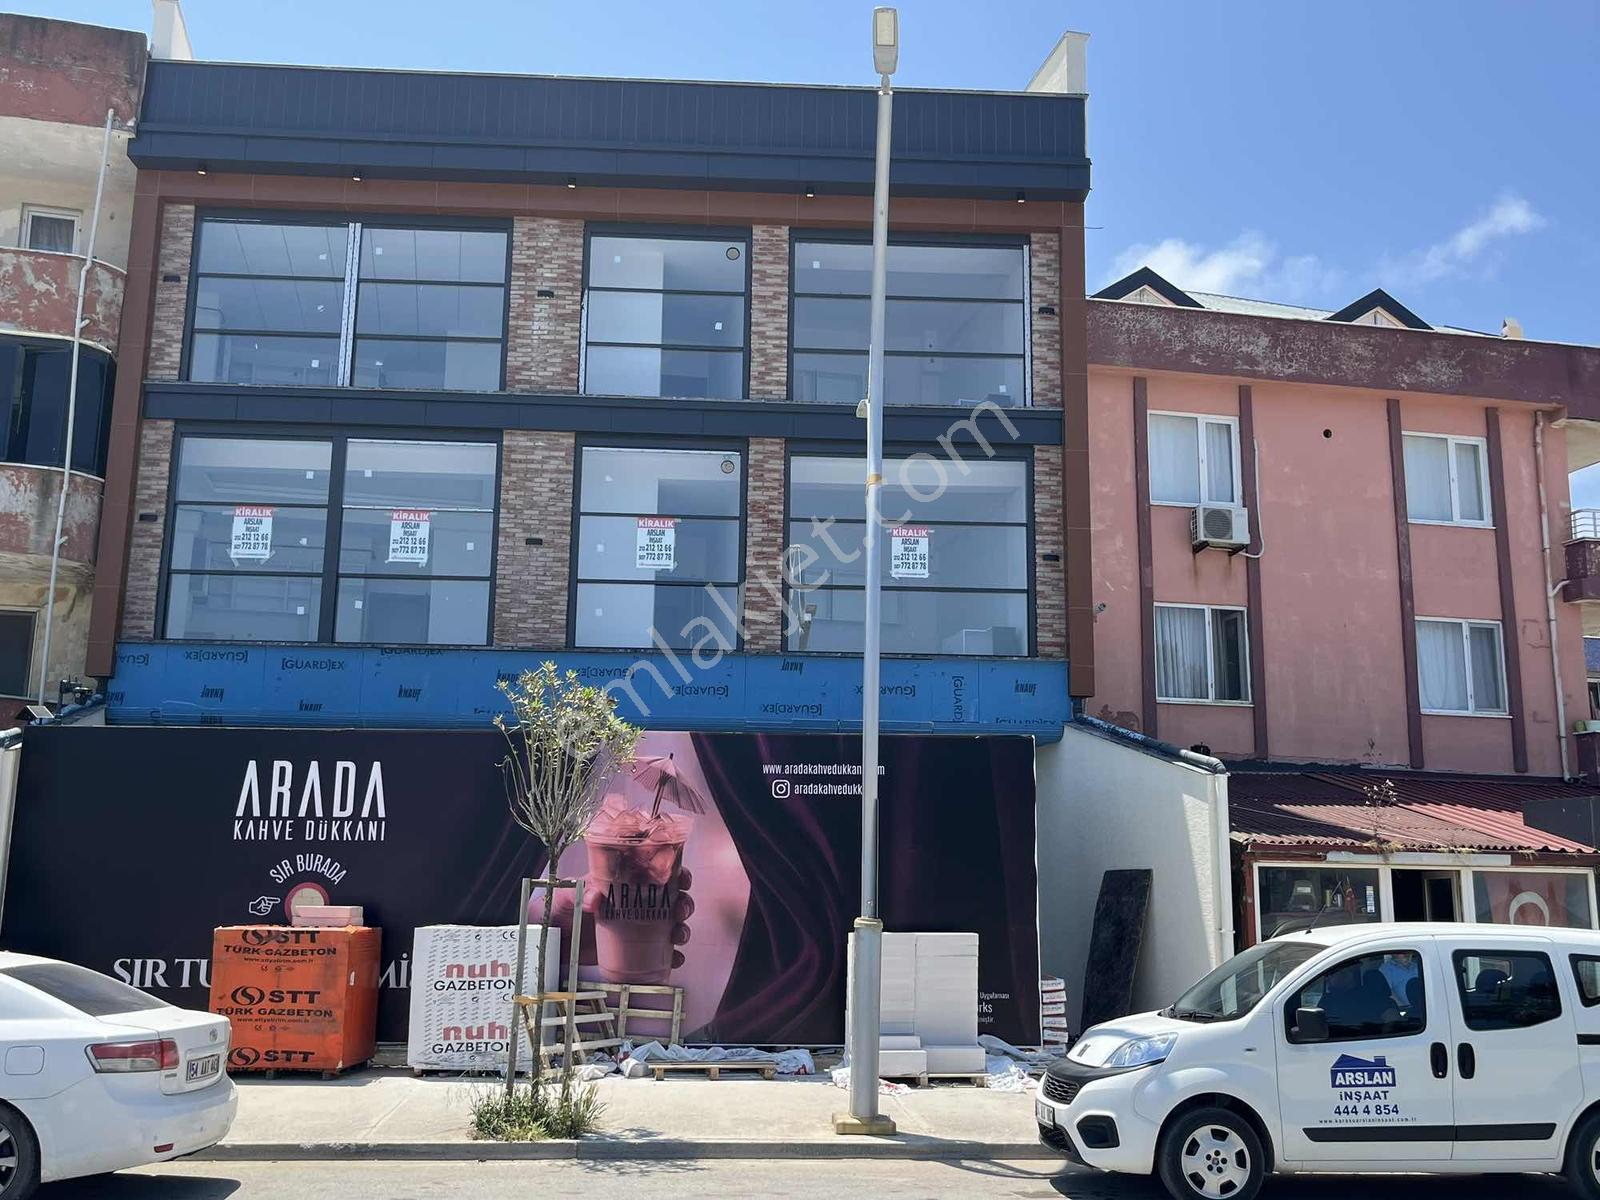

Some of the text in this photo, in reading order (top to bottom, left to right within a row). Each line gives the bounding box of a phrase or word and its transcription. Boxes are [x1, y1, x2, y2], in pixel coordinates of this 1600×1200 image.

[235, 506, 272, 516] KİRALIK
[393, 510, 429, 521] KİRALIK
[638, 517, 674, 527] KİRALIK
[242, 533, 252, 541] 212
[253, 533, 260, 541] 12
[893, 527, 928, 537] KİRALIK
[242, 542, 252, 550] 772
[400, 537, 410, 545] 212
[411, 537, 417, 545] 12
[901, 553, 910, 561] 212
[911, 553, 917, 561] 12
[901, 562, 911, 570] 772
[184, 650, 249, 664] [GUARD]EX
[282, 658, 345, 671] [GUARD]EX
[398, 685, 422, 702] KNAUF
[855, 685, 916, 697] [GUARX
[1014, 679, 1036, 697] KNAUF
[762, 703, 823, 716] [GUARD]EX
[762, 763, 885, 776] www.aradakahvedukkanm
[235, 760, 386, 818] ARADA
[794, 783, 863, 795] aradakahvedukk
[233, 820, 386, 841] KAHVE DÜKKANI
[269, 853, 347, 885] SIR BURADA
[607, 883, 671, 908] ARADA
[224, 944, 337, 956] TÜRK GAZBETON
[113, 958, 171, 988] SIR
[174, 958, 212, 988] TU
[446, 960, 510, 978] nuh
[268, 990, 320, 1003] STT
[216, 1007, 333, 1018] TÜRK GAZBETON
[978, 1002, 993, 1013] rks
[443, 1022, 508, 1041] nuh
[263, 1050, 315, 1063] STT
[1335, 1072, 1393, 1086] ARSLAN
[1334, 1104, 1399, 1116] 444 4 854
